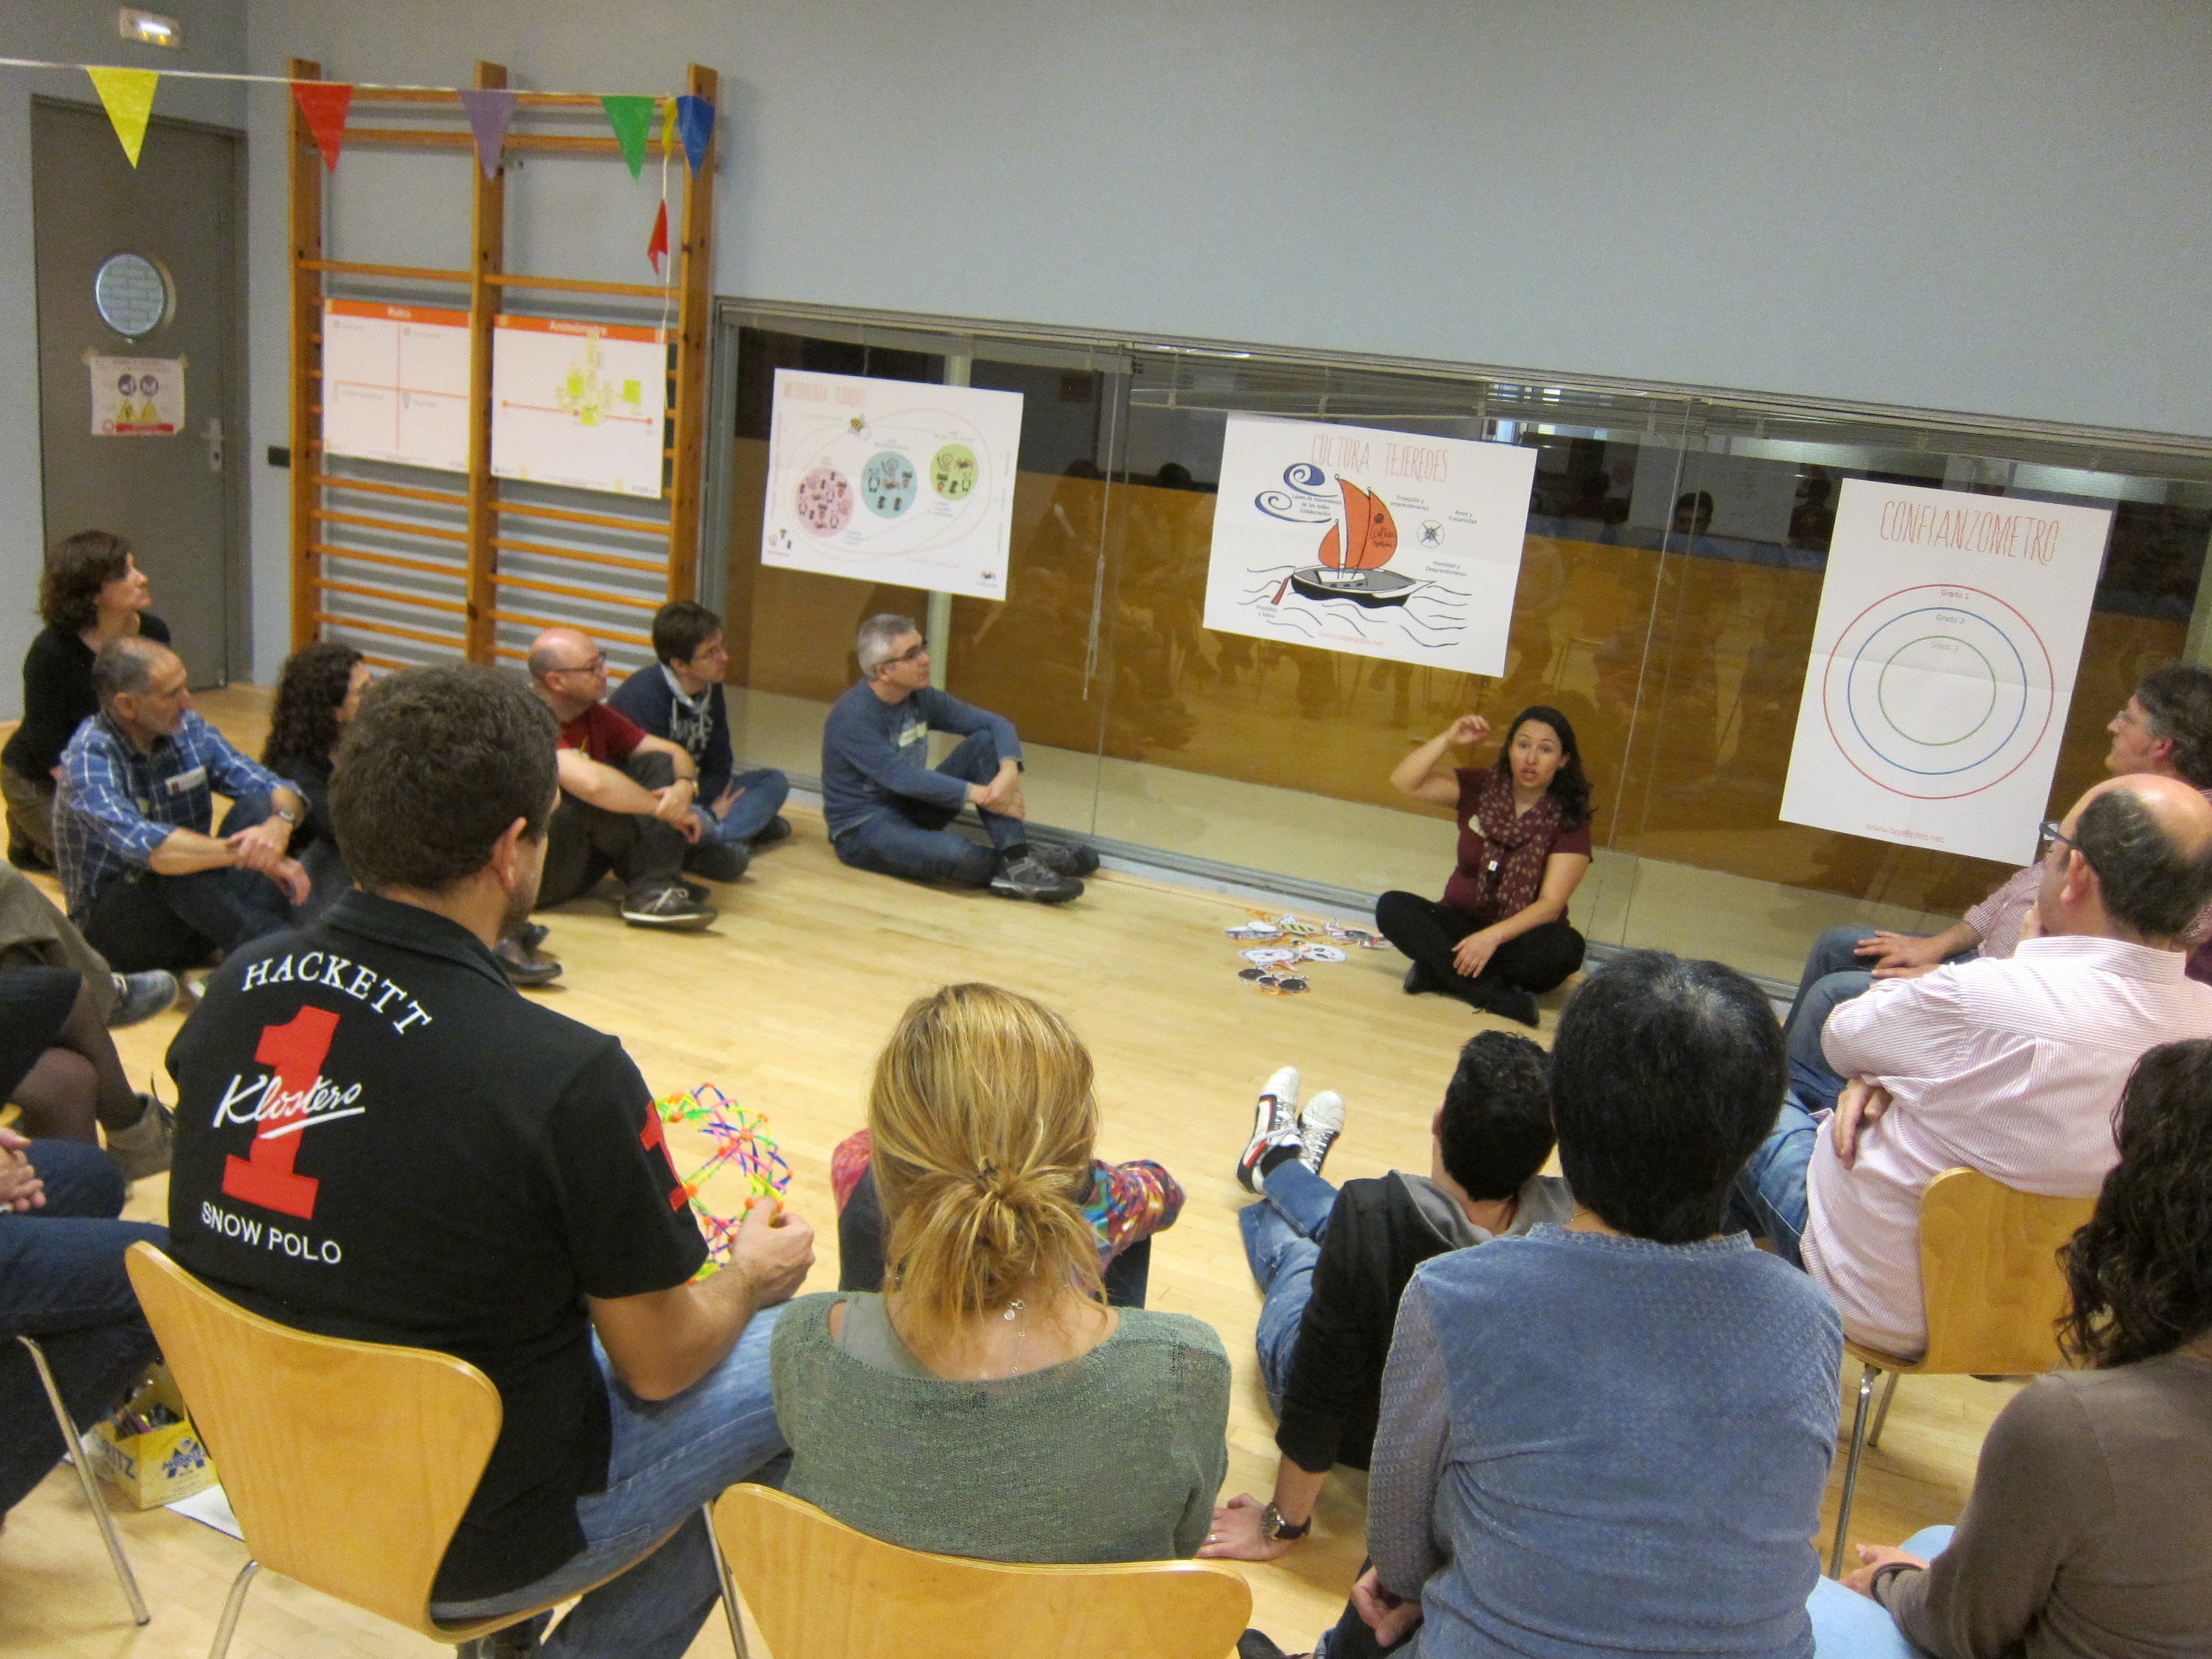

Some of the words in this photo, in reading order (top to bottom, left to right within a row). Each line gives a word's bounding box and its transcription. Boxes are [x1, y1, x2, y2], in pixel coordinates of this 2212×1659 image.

[1311, 434, 1370, 474] CULTURA
[1386, 443, 1449, 482] TEJEREDES
[1936, 614, 1958, 623] Grado
[1940, 589, 1963, 599] Grado
[241, 951, 433, 1035] HACKETT
[222, 1004, 341, 1221] 1
[201, 1201, 263, 1246] SNOW
[268, 1227, 343, 1265] POLO
